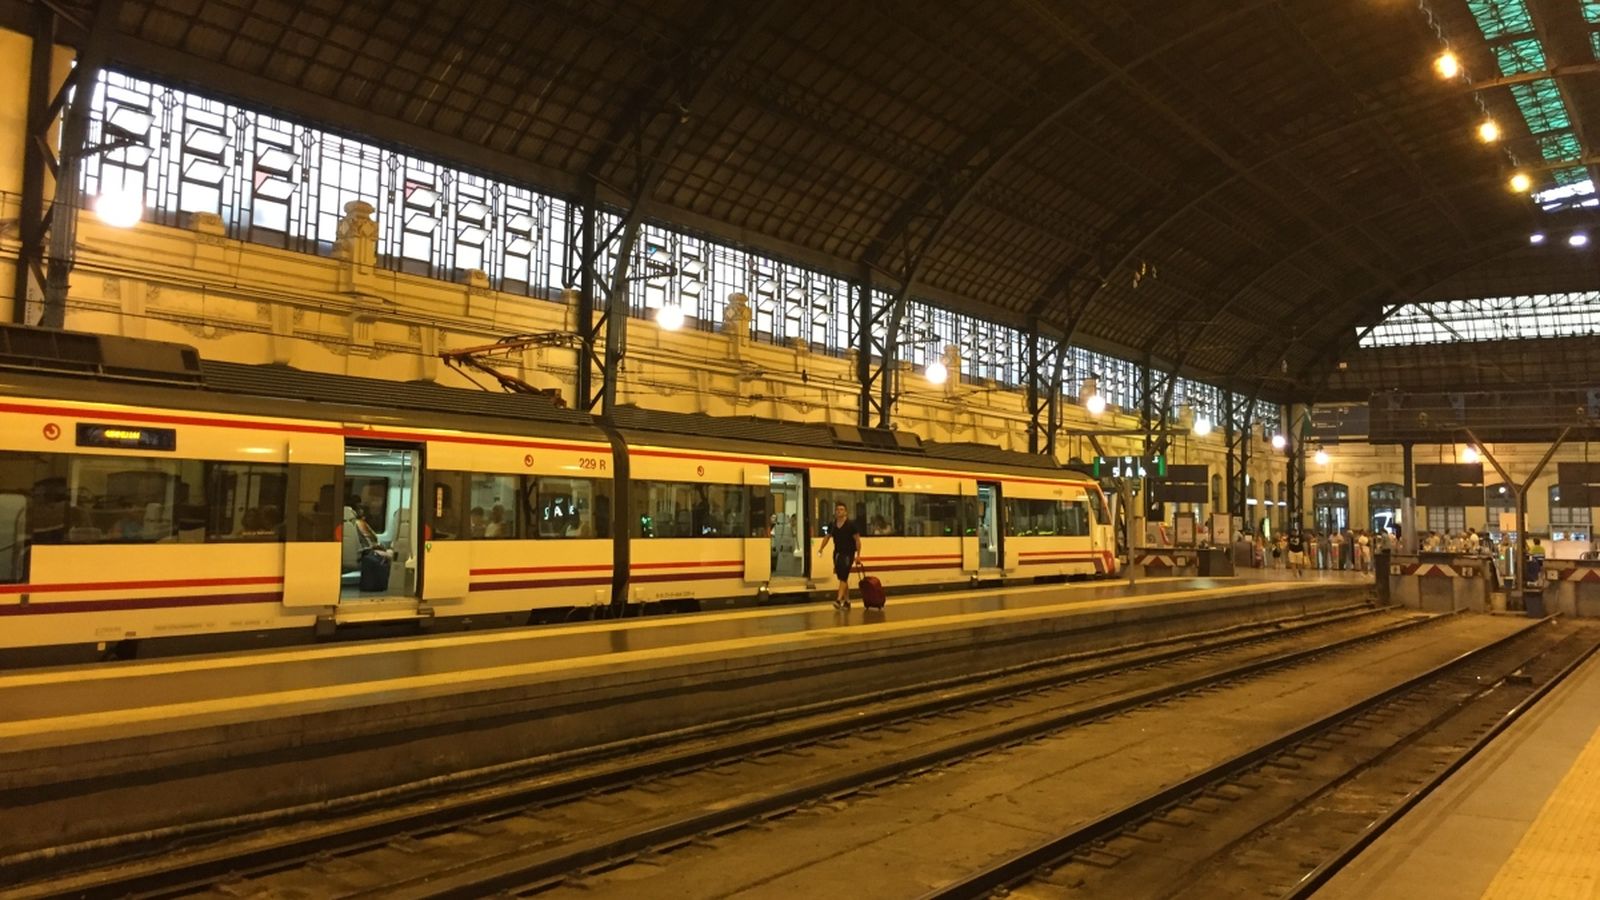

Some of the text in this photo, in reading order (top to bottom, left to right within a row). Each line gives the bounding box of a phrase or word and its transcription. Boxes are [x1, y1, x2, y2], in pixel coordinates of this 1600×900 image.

[579, 457, 606, 471] 229 R
[1125, 467, 1133, 477] A
